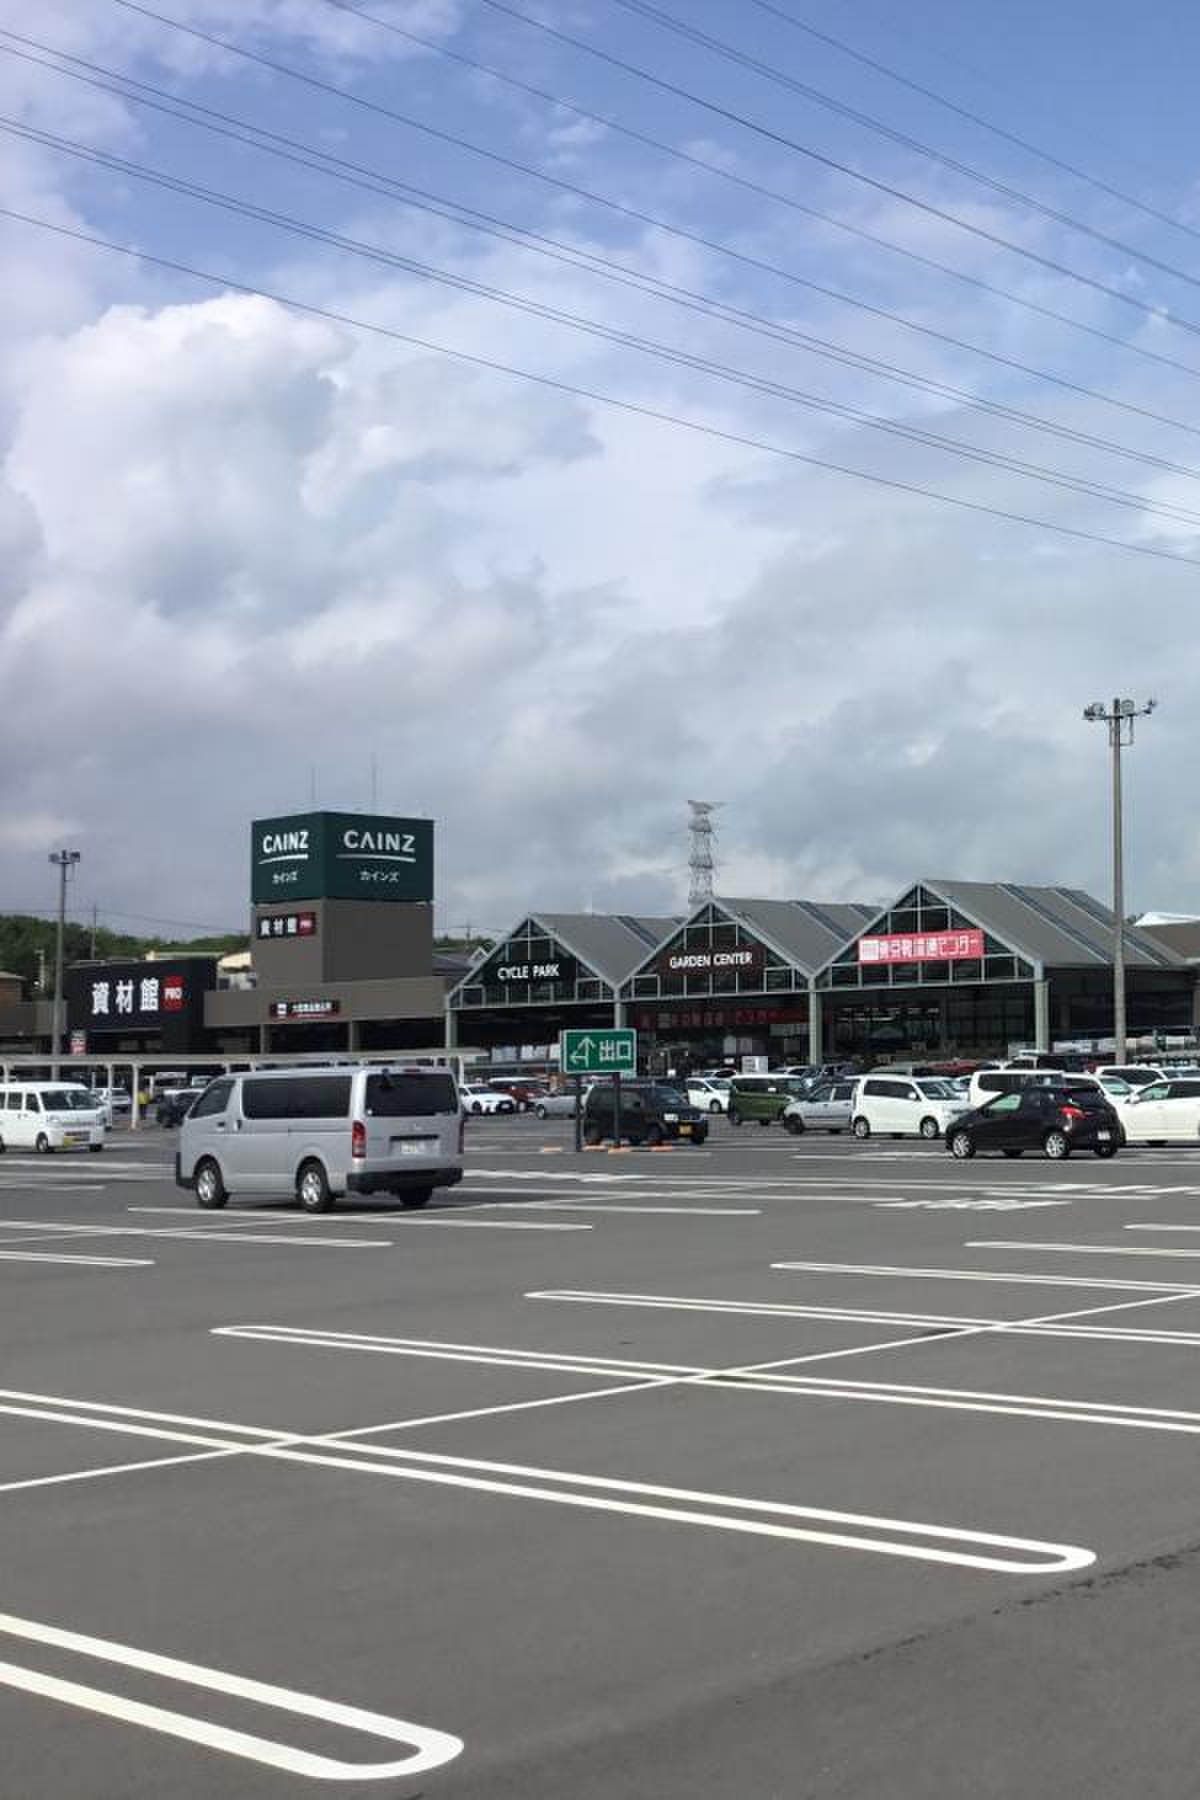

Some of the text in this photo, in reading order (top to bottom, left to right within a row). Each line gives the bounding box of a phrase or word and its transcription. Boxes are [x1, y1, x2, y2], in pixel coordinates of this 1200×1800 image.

[263, 831, 309, 853] CAINZ
[343, 829, 416, 853] CAINZ
[359, 870, 400, 883] カインズ
[669, 950, 753, 969] GARDEN CENTER
[497, 963, 560, 980] CYCLE PARK
[91, 977, 183, 1015] 資材館 PRO
[599, 1038, 632, 1061] 出口
